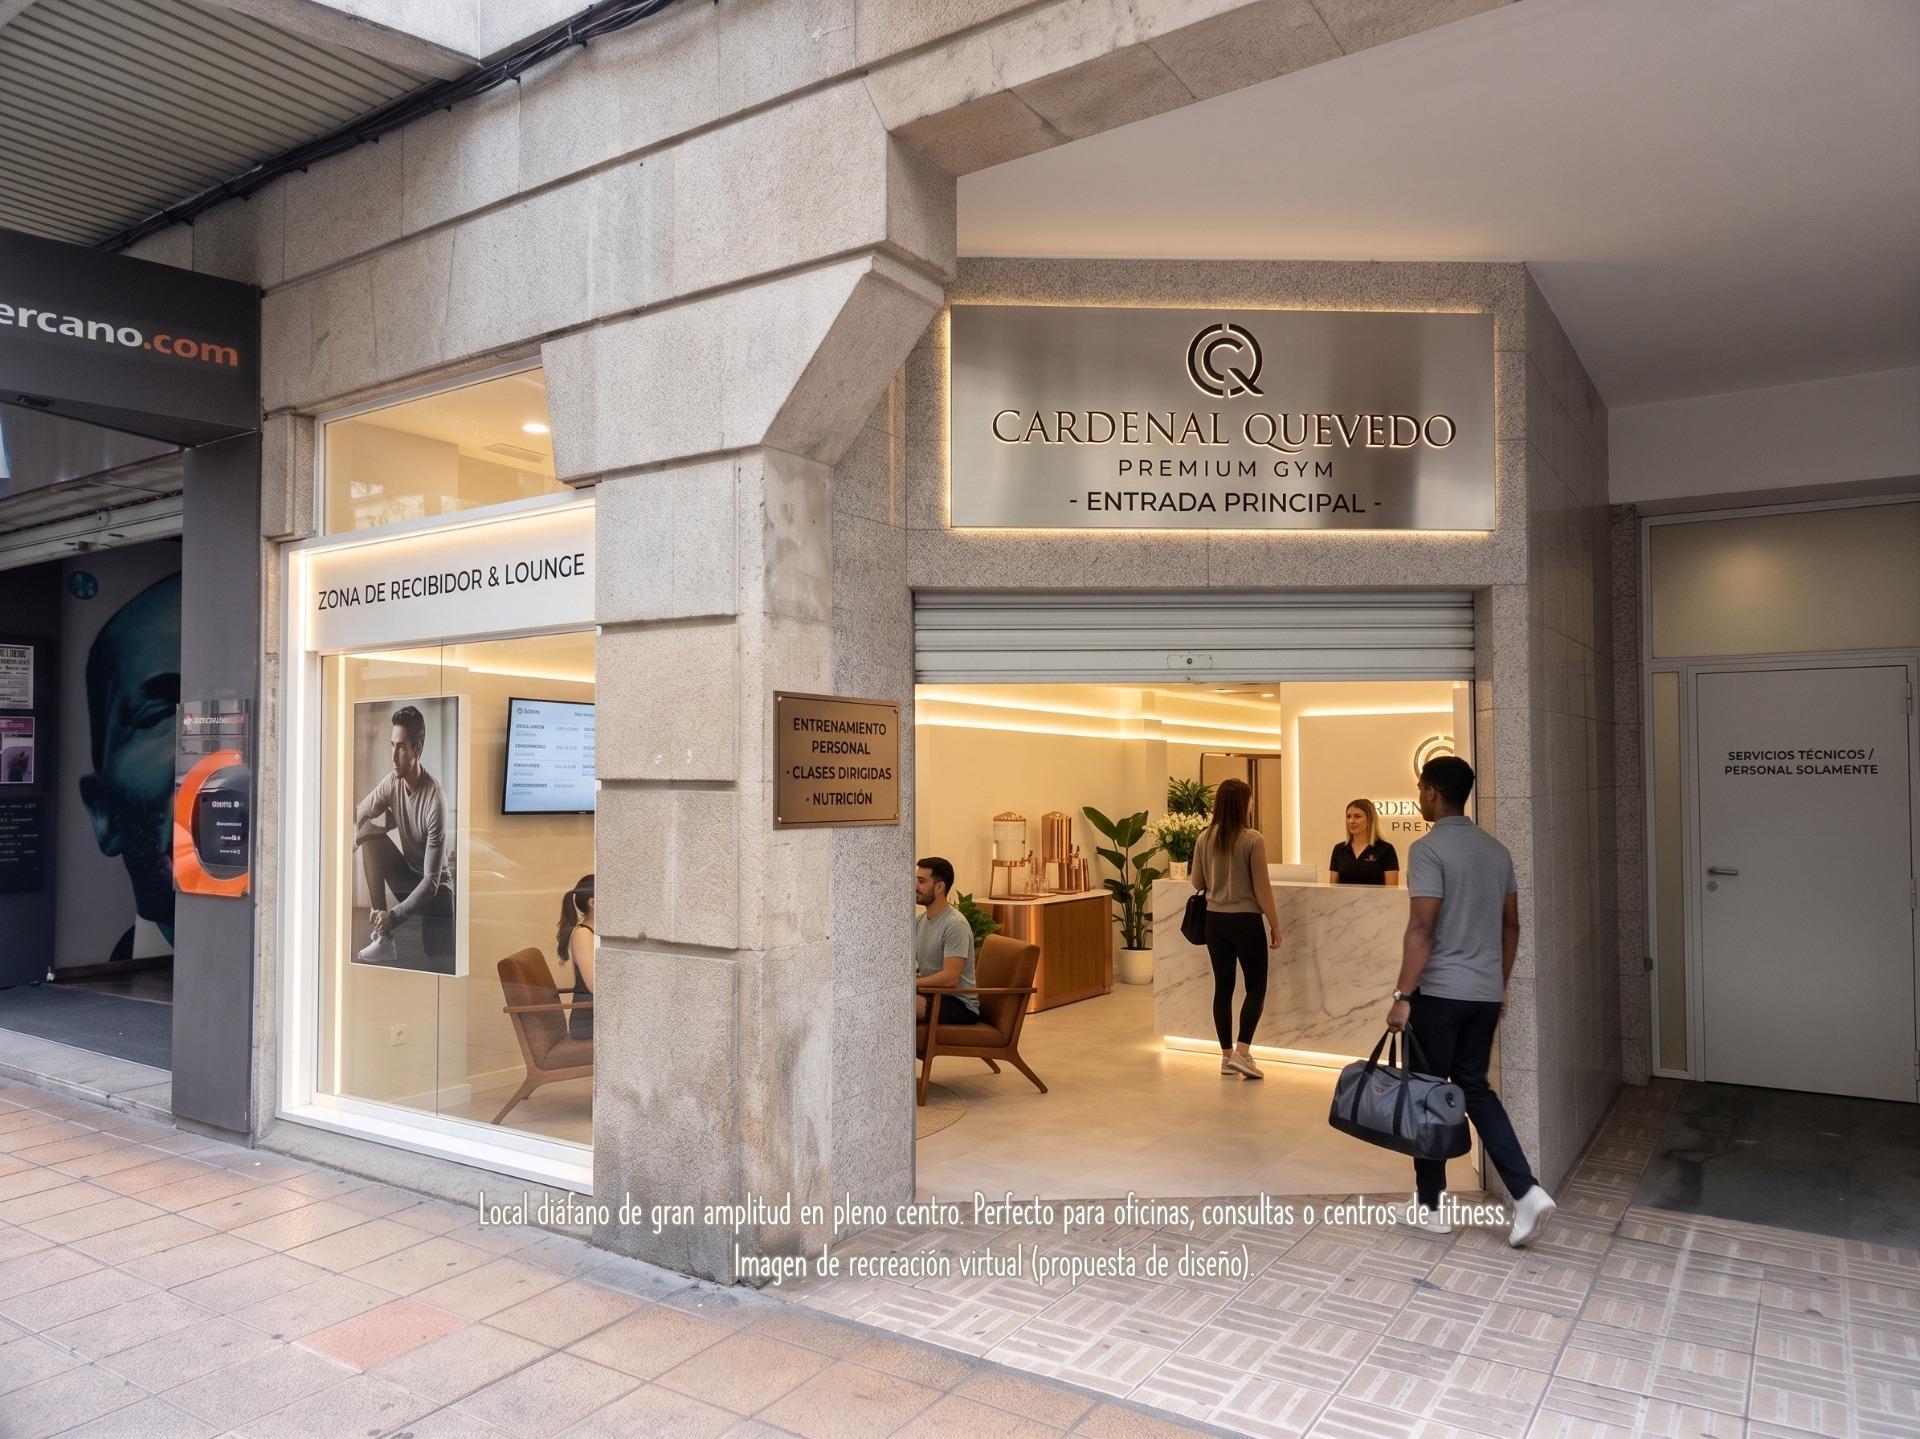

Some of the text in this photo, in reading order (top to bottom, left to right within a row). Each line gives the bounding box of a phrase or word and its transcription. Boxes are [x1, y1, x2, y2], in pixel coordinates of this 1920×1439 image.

[991, 409, 1457, 454] CARDENAL QUEVEDO
[1118, 459, 1334, 479] PREMIUM GYM
[1087, 491, 1217, 513] ENTRADA
[1224, 492, 1366, 514] PRINCIPAL
[318, 552, 585, 611] ZONA DE RECIBIDOR & LOUNGE
[793, 717, 887, 736] ENTRENAMIENTO
[811, 740, 871, 755] PERSONAL
[1727, 750, 1796, 761] SERVICIOS
[1798, 748, 1866, 760] TÉCNICOS
[792, 766, 892, 781] CLASES DIRIGIDAS
[1724, 764, 1880, 776] PERSONAL SOLAMENTE
[813, 789, 873, 806] NUTRICIÓN
[1373, 801, 1422, 816] RDEN
